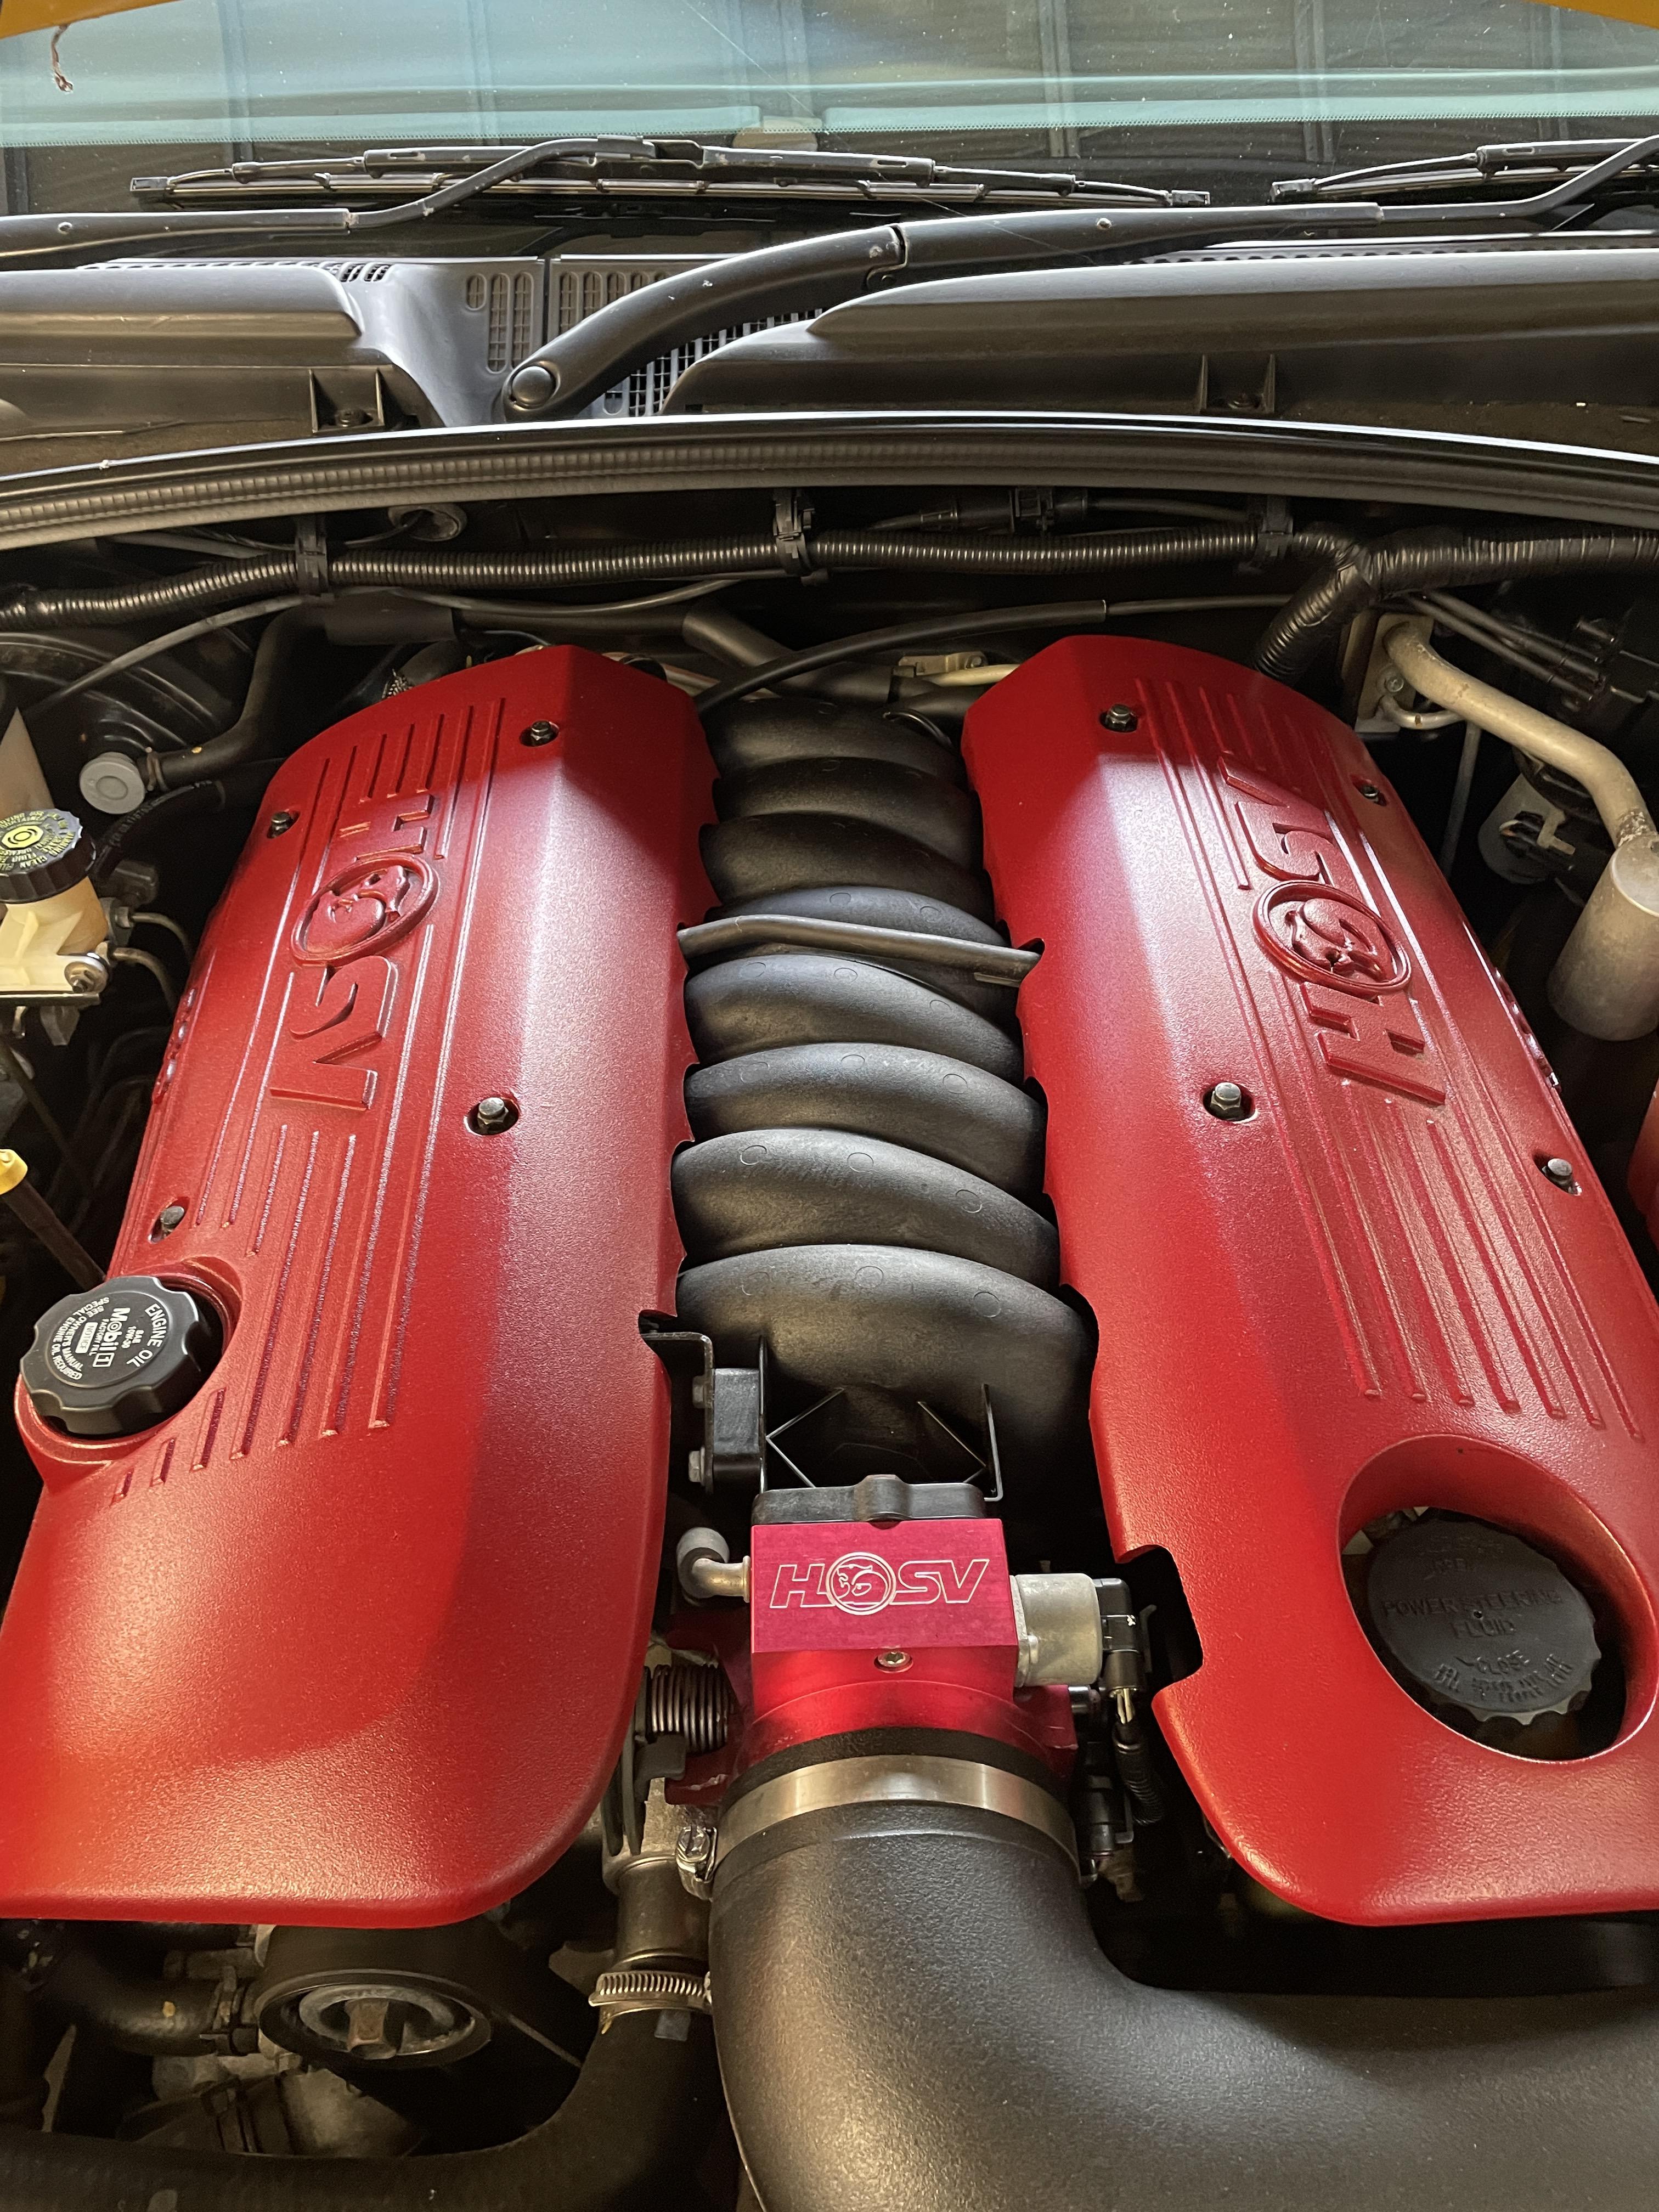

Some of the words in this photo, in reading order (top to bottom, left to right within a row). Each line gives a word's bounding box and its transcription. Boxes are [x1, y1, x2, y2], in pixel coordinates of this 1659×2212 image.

[73, 1297, 110, 1317] SPECIAL
[86, 1306, 104, 1317] SEE
[53, 1317, 76, 1342] ENGINE
[76, 1324, 97, 1351] NOTICE
[94, 1319, 109, 1344] FACTORY
[103, 1308, 131, 1351] Mobil
[145, 1304, 167, 1347] ENGINE
[51, 1343, 60, 1356] OIL
[61, 1347, 83, 1372] MANUAL
[127, 1349, 153, 1367] OIL
[53, 1356, 82, 1380] REQUIRED
[1382, 1598, 1458, 1617] POWER
[1451, 1618, 1516, 1639] FLUID
